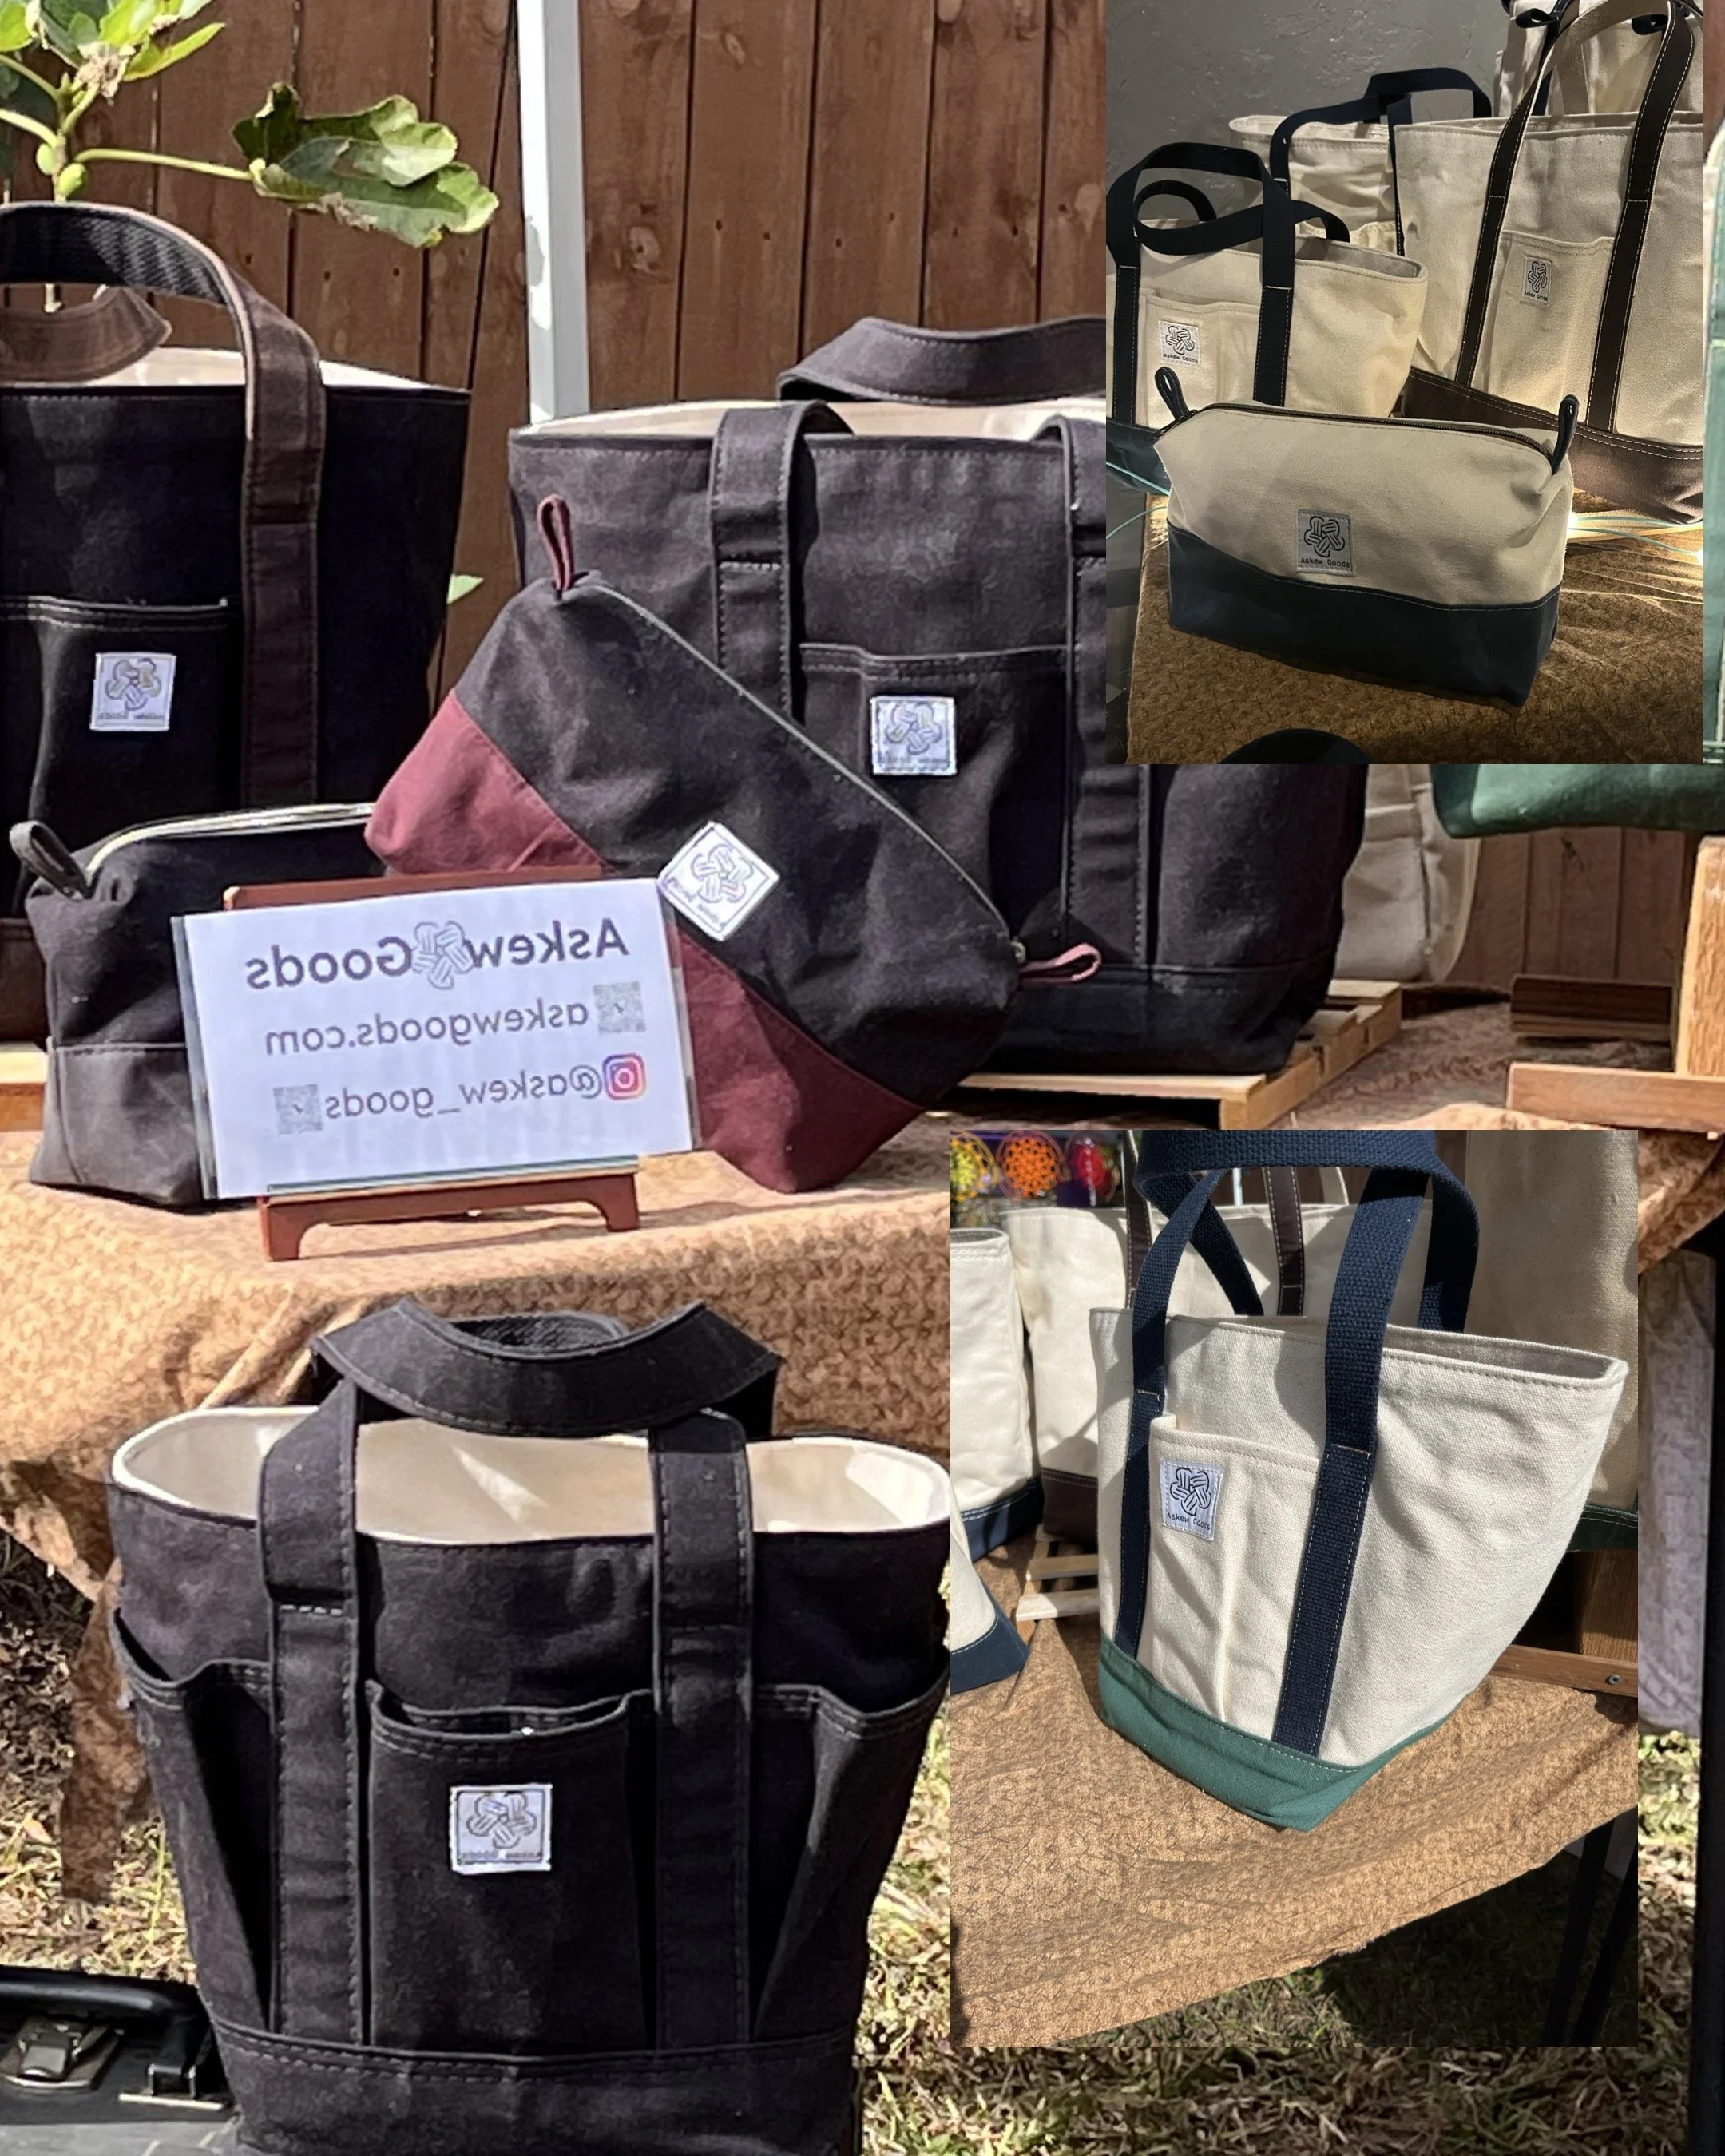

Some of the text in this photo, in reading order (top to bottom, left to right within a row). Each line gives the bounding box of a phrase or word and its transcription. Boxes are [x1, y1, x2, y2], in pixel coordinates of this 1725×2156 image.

[1327, 559, 1350, 568] Goods
[1167, 1512, 1211, 1530] Askew Goods
